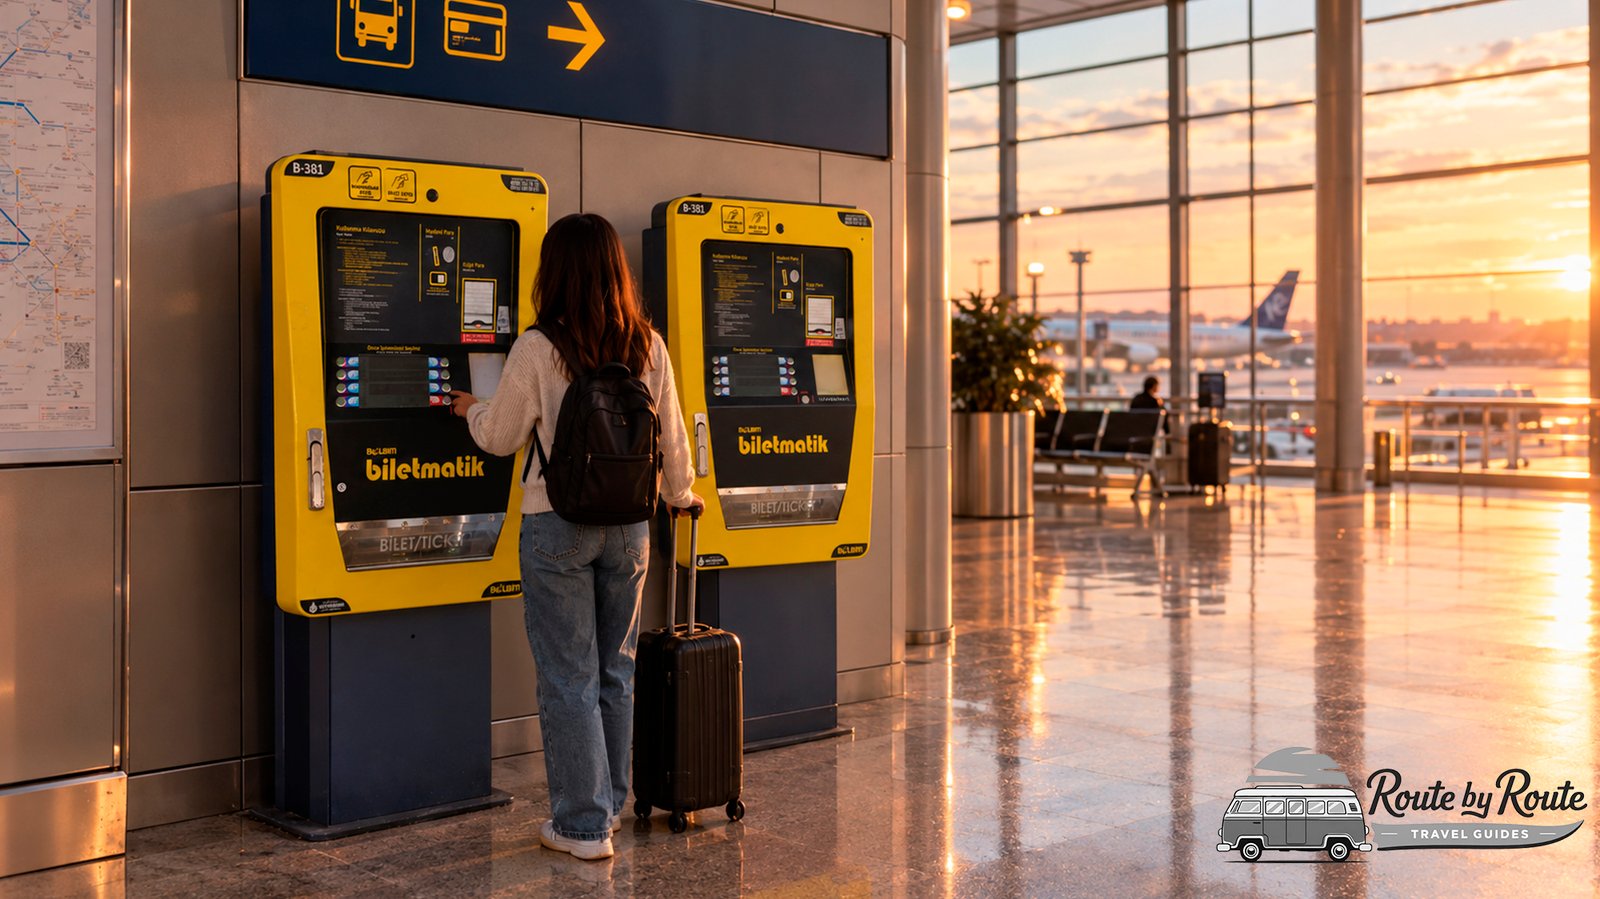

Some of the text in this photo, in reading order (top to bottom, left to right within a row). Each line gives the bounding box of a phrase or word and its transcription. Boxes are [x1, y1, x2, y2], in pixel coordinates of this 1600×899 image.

[293, 162, 324, 175] B-381
[682, 203, 705, 214] B-381
[738, 434, 829, 455] biletmatik
[366, 455, 485, 481] biletmatik
